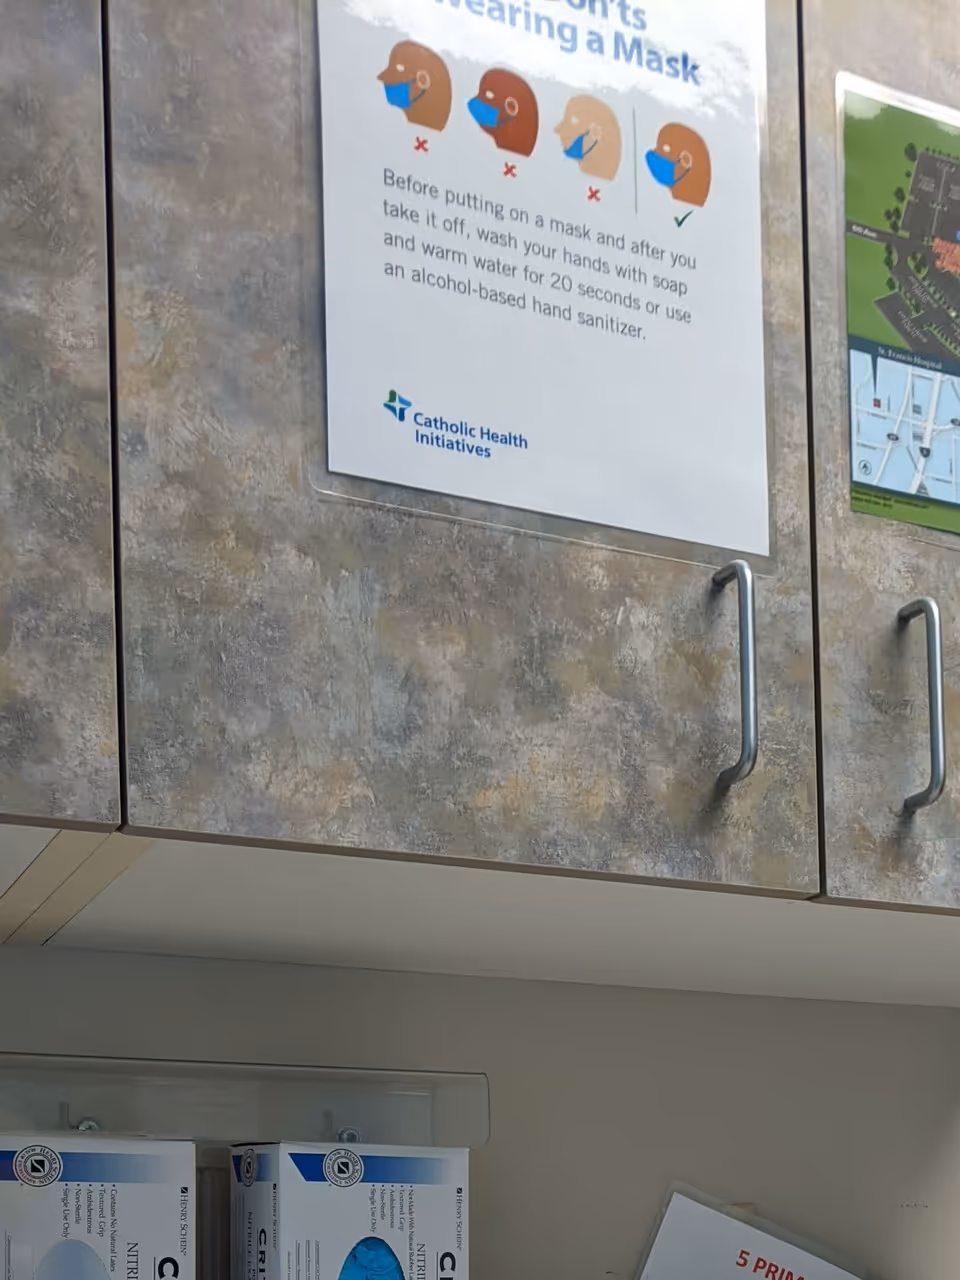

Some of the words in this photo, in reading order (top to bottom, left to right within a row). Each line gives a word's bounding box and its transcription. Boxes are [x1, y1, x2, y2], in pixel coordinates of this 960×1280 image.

[586, 29, 605, 56] a
[613, 31, 702, 86] Mask
[383, 168, 438, 199] Before
[446, 188, 504, 221] putting
[509, 206, 529, 226] on
[535, 213, 545, 229] a
[550, 216, 591, 242] mask
[597, 228, 626, 251] and
[631, 236, 665, 262] after
[670, 250, 697, 271] you
[383, 199, 420, 224] take
[426, 210, 437, 229] it
[443, 217, 471, 240] off,
[476, 223, 518, 249] wash
[523, 238, 557, 260] your
[563, 246, 611, 275] hands
[615, 262, 648, 285] with
[653, 272, 688, 298] soap
[383, 230, 415, 252] and
[421, 242, 467, 265] warm
[473, 255, 517, 279] water
[523, 265, 545, 285] for
[550, 273, 573, 293] 20
[578, 279, 641, 312] seconds
[645, 301, 660, 315] or
[666, 305, 692, 324] use
[384, 262, 405, 280] an
[411, 267, 527, 310] alcohol-based
[532, 296, 572, 322] hand
[577, 308, 647, 341] sanitizer.
[913, 355, 943, 370] Hospital
[413, 412, 476, 438] Catholic
[480, 426, 528, 449] Health
[415, 430, 491, 458] Initiatives
[61, 1187, 70, 1208] Single
[74, 1188, 82, 1225] Non-Sterile
[98, 1189, 106, 1219] Textured
[180, 1195, 188, 1222] HENRY
[368, 1187, 376, 1206] Single
[61, 1222, 70, 1238] Only
[97, 1220, 105, 1237] Grip
[110, 1218, 117, 1229] No
[180, 1223, 188, 1251] SCHEIN
[368, 1218, 377, 1233] Only
[109, 1255, 117, 1272] Latex
[735, 1249, 750, 1267] 5
